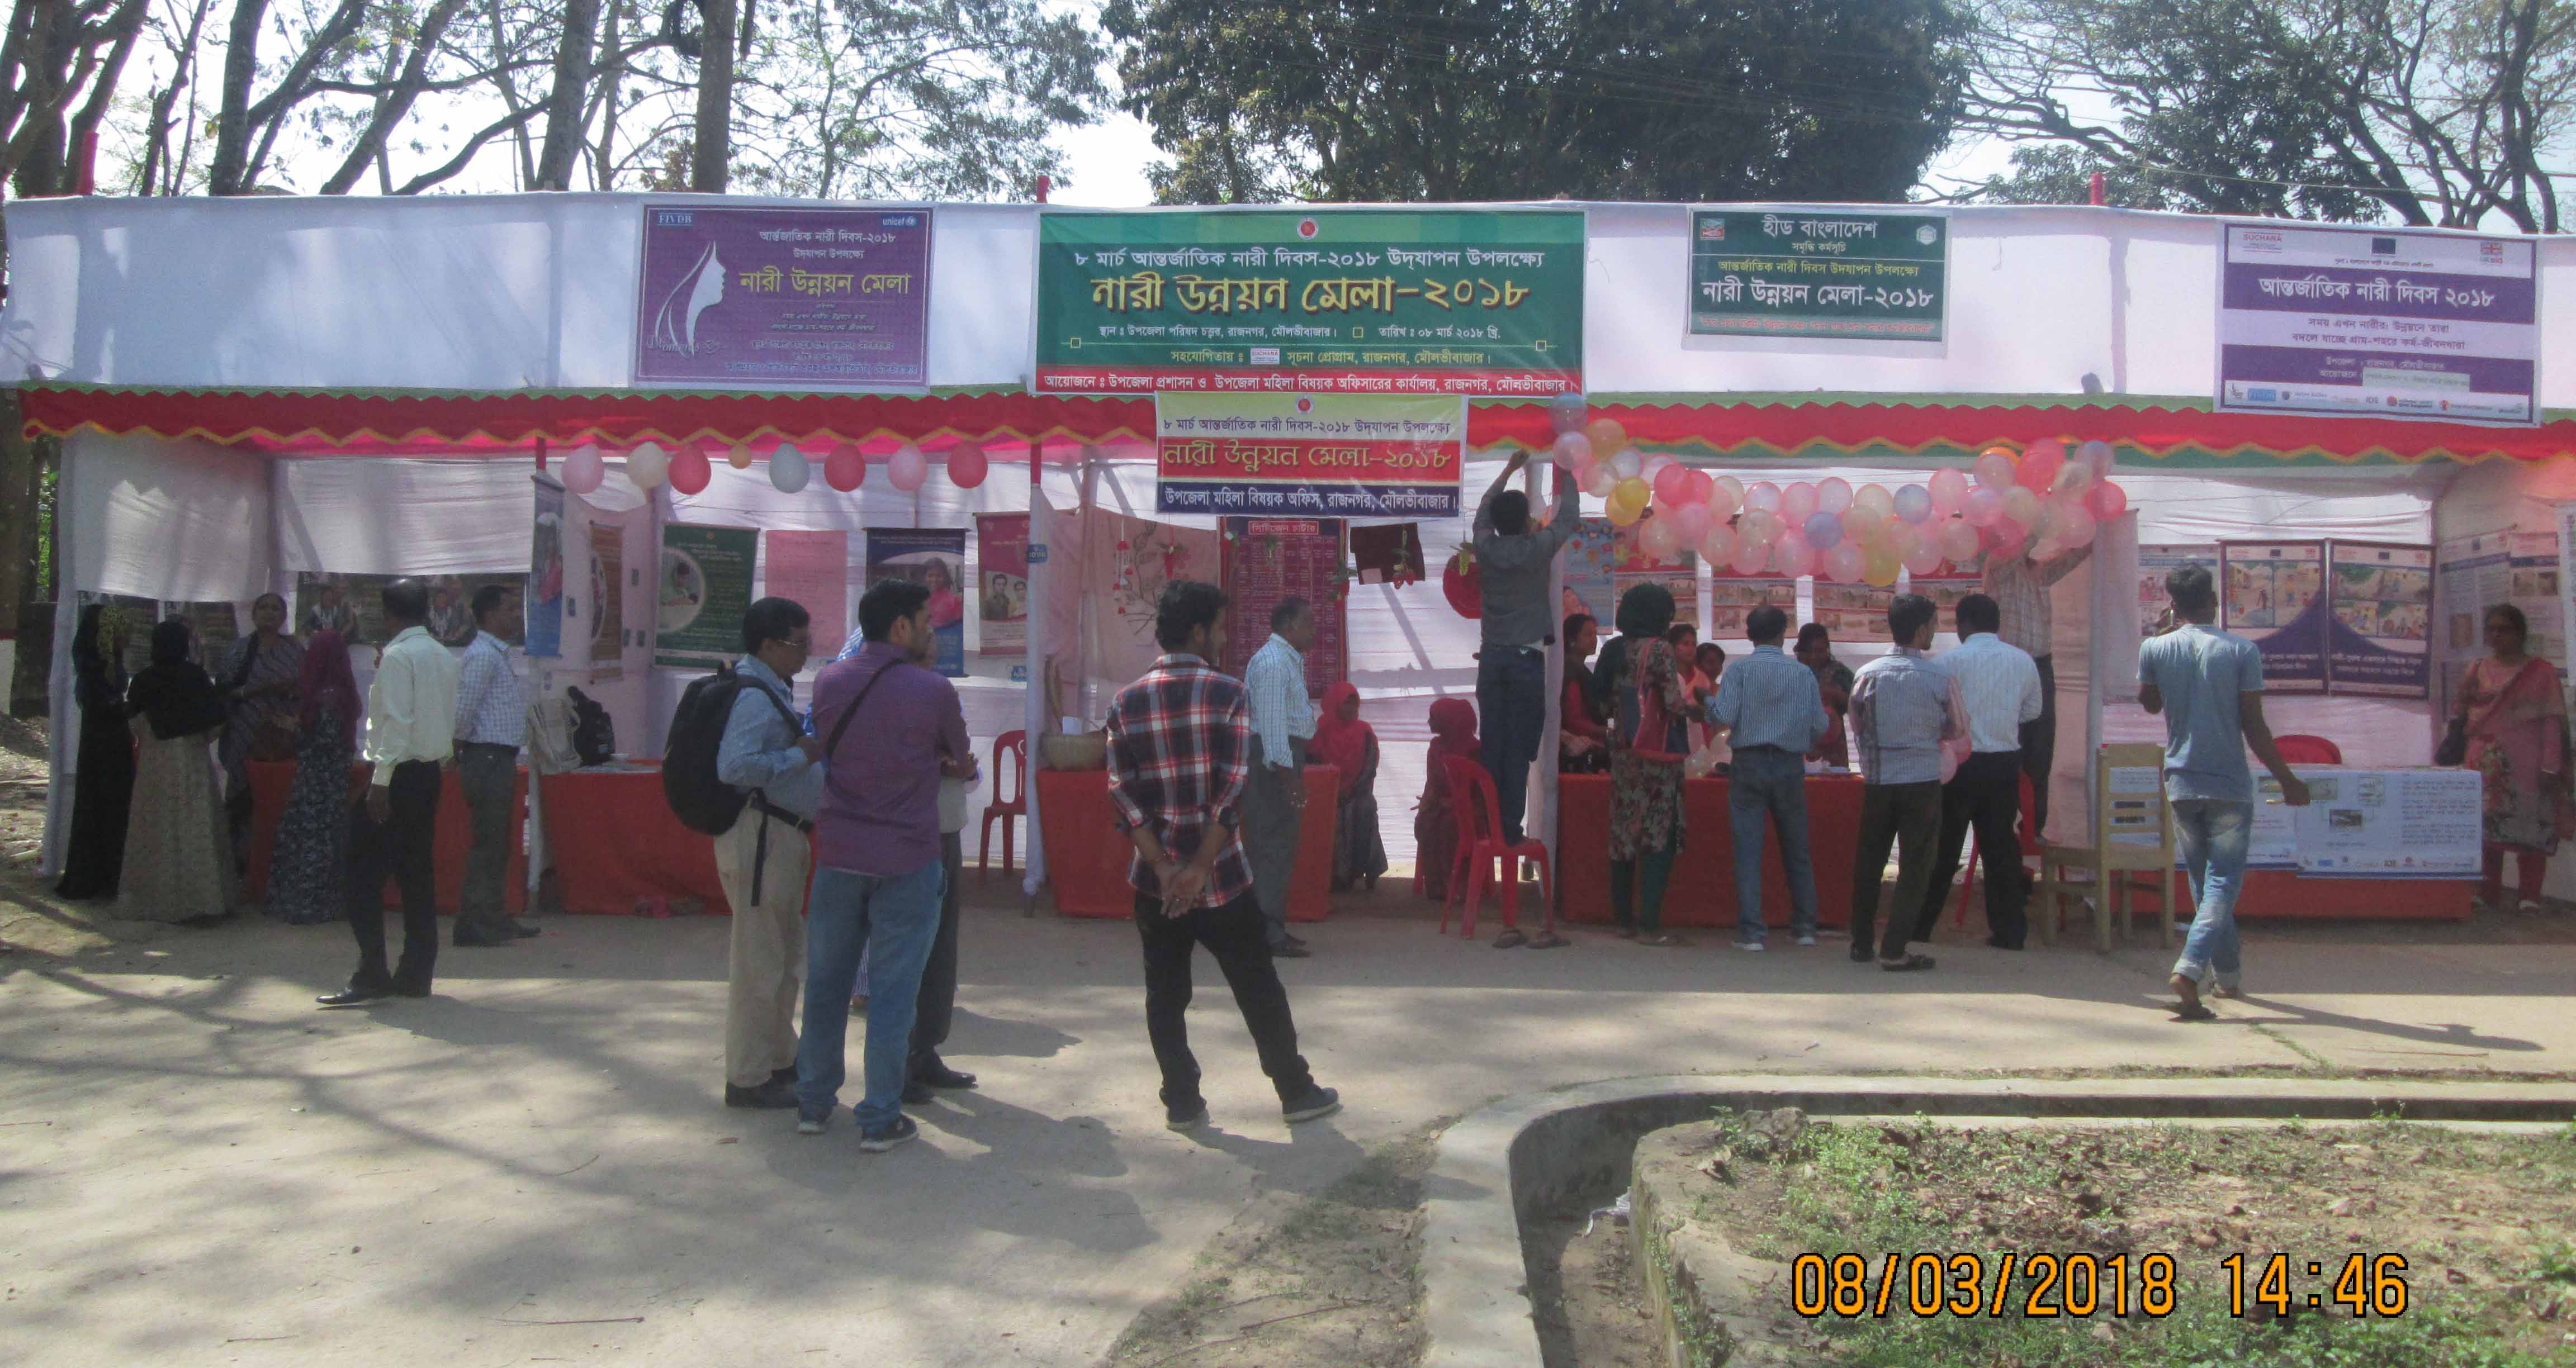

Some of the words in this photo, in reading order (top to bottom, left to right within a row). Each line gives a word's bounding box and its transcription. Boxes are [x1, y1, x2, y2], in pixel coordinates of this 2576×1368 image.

[659, 214, 692, 224] FIVDB
[883, 217, 904, 226] unicef
[1761, 214, 1796, 239] হীড
[1801, 218, 1878, 239] বাংলাদেশ
[815, 228, 835, 243] নারী
[838, 229, 896, 244] দিবস-২০১৮
[2243, 234, 2282, 243] SUCHANA
[1075, 251, 1088, 265] ৮
[1095, 248, 1126, 267] মার্চ
[1131, 247, 1227, 267] আন্তর্জাতিক
[1231, 247, 1268, 267] নারী
[1273, 247, 1380, 268] দিবস-২০১৮
[1466, 248, 1545, 268] উপলক্ষ্যে
[1718, 259, 1774, 274] আন্তর্জাতিক
[1776, 260, 1798, 274] নারী
[1801, 261, 1827, 275] দিবস
[738, 265, 784, 293] নারী
[790, 267, 855, 298] উন্নয়ন
[861, 273, 912, 294] মেলা
[1090, 270, 1166, 312] নারী
[1172, 274, 1289, 314] উন্নয়ন
[1301, 276, 1531, 314] মেলা-২০১৮
[1701, 275, 1744, 303] নারী
[1750, 277, 1811, 308] উন্নয়ন
[1817, 282, 1934, 309] মেলা-২০১৮
[2258, 274, 2350, 301] আন্তর্জাতিক
[2356, 278, 2390, 302] নারী
[2397, 280, 2439, 305] দিবস
[2445, 288, 2495, 308] ২০১৮
[1099, 326, 1116, 338] স্থান
[1127, 324, 1165, 336] উপজেলা
[1169, 324, 1199, 336] পরিষদ
[1228, 326, 1268, 339] রাজনগর,
[1379, 324, 1407, 338] তারিখ
[1418, 327, 1433, 337] ০৮
[1436, 324, 1453, 338] মার্চ
[1456, 327, 1484, 339] ২০১৮
[1171, 348, 1235, 363] সহযোগিতায়
[1318, 352, 1358, 364] প্রোগ্রাম,
[1363, 352, 1410, 366] রাজনগর,
[1044, 374, 1096, 388] আয়োজনে
[1109, 374, 1154, 390] উপজেলা
[1156, 376, 1193, 390] প্রশাসন
[1198, 377, 1206, 389] ও
[1215, 374, 1260, 391] উপজেলা
[1263, 374, 1295, 391] মহিলা
[1298, 374, 1333, 390] বিষয়ক
[1337, 374, 1391, 391] অফিসারের
[1396, 374, 1440, 393] কার্যালয়,
[1445, 378, 1491, 393] রাজনগর,
[1164, 420, 1172, 430] ৮
[1176, 416, 1195, 430] মার্চ
[1199, 416, 1256, 431] আন্তর্জাতিক
[1261, 417, 1282, 431] নারী
[1286, 417, 1351, 433] দিবস-২০১৮
[1403, 420, 1451, 434] উপলক্ষ্যে
[1162, 439, 1218, 467] নারী
[1308, 445, 1452, 468] মেলা-২০১৮
[1165, 486, 1210, 505] উপজেলা
[1214, 488, 1244, 505] মহিলা
[1248, 488, 1284, 507] বিষয়ক
[1287, 489, 1324, 509] অফিস,
[1328, 492, 1375, 510] রাজনগর,
